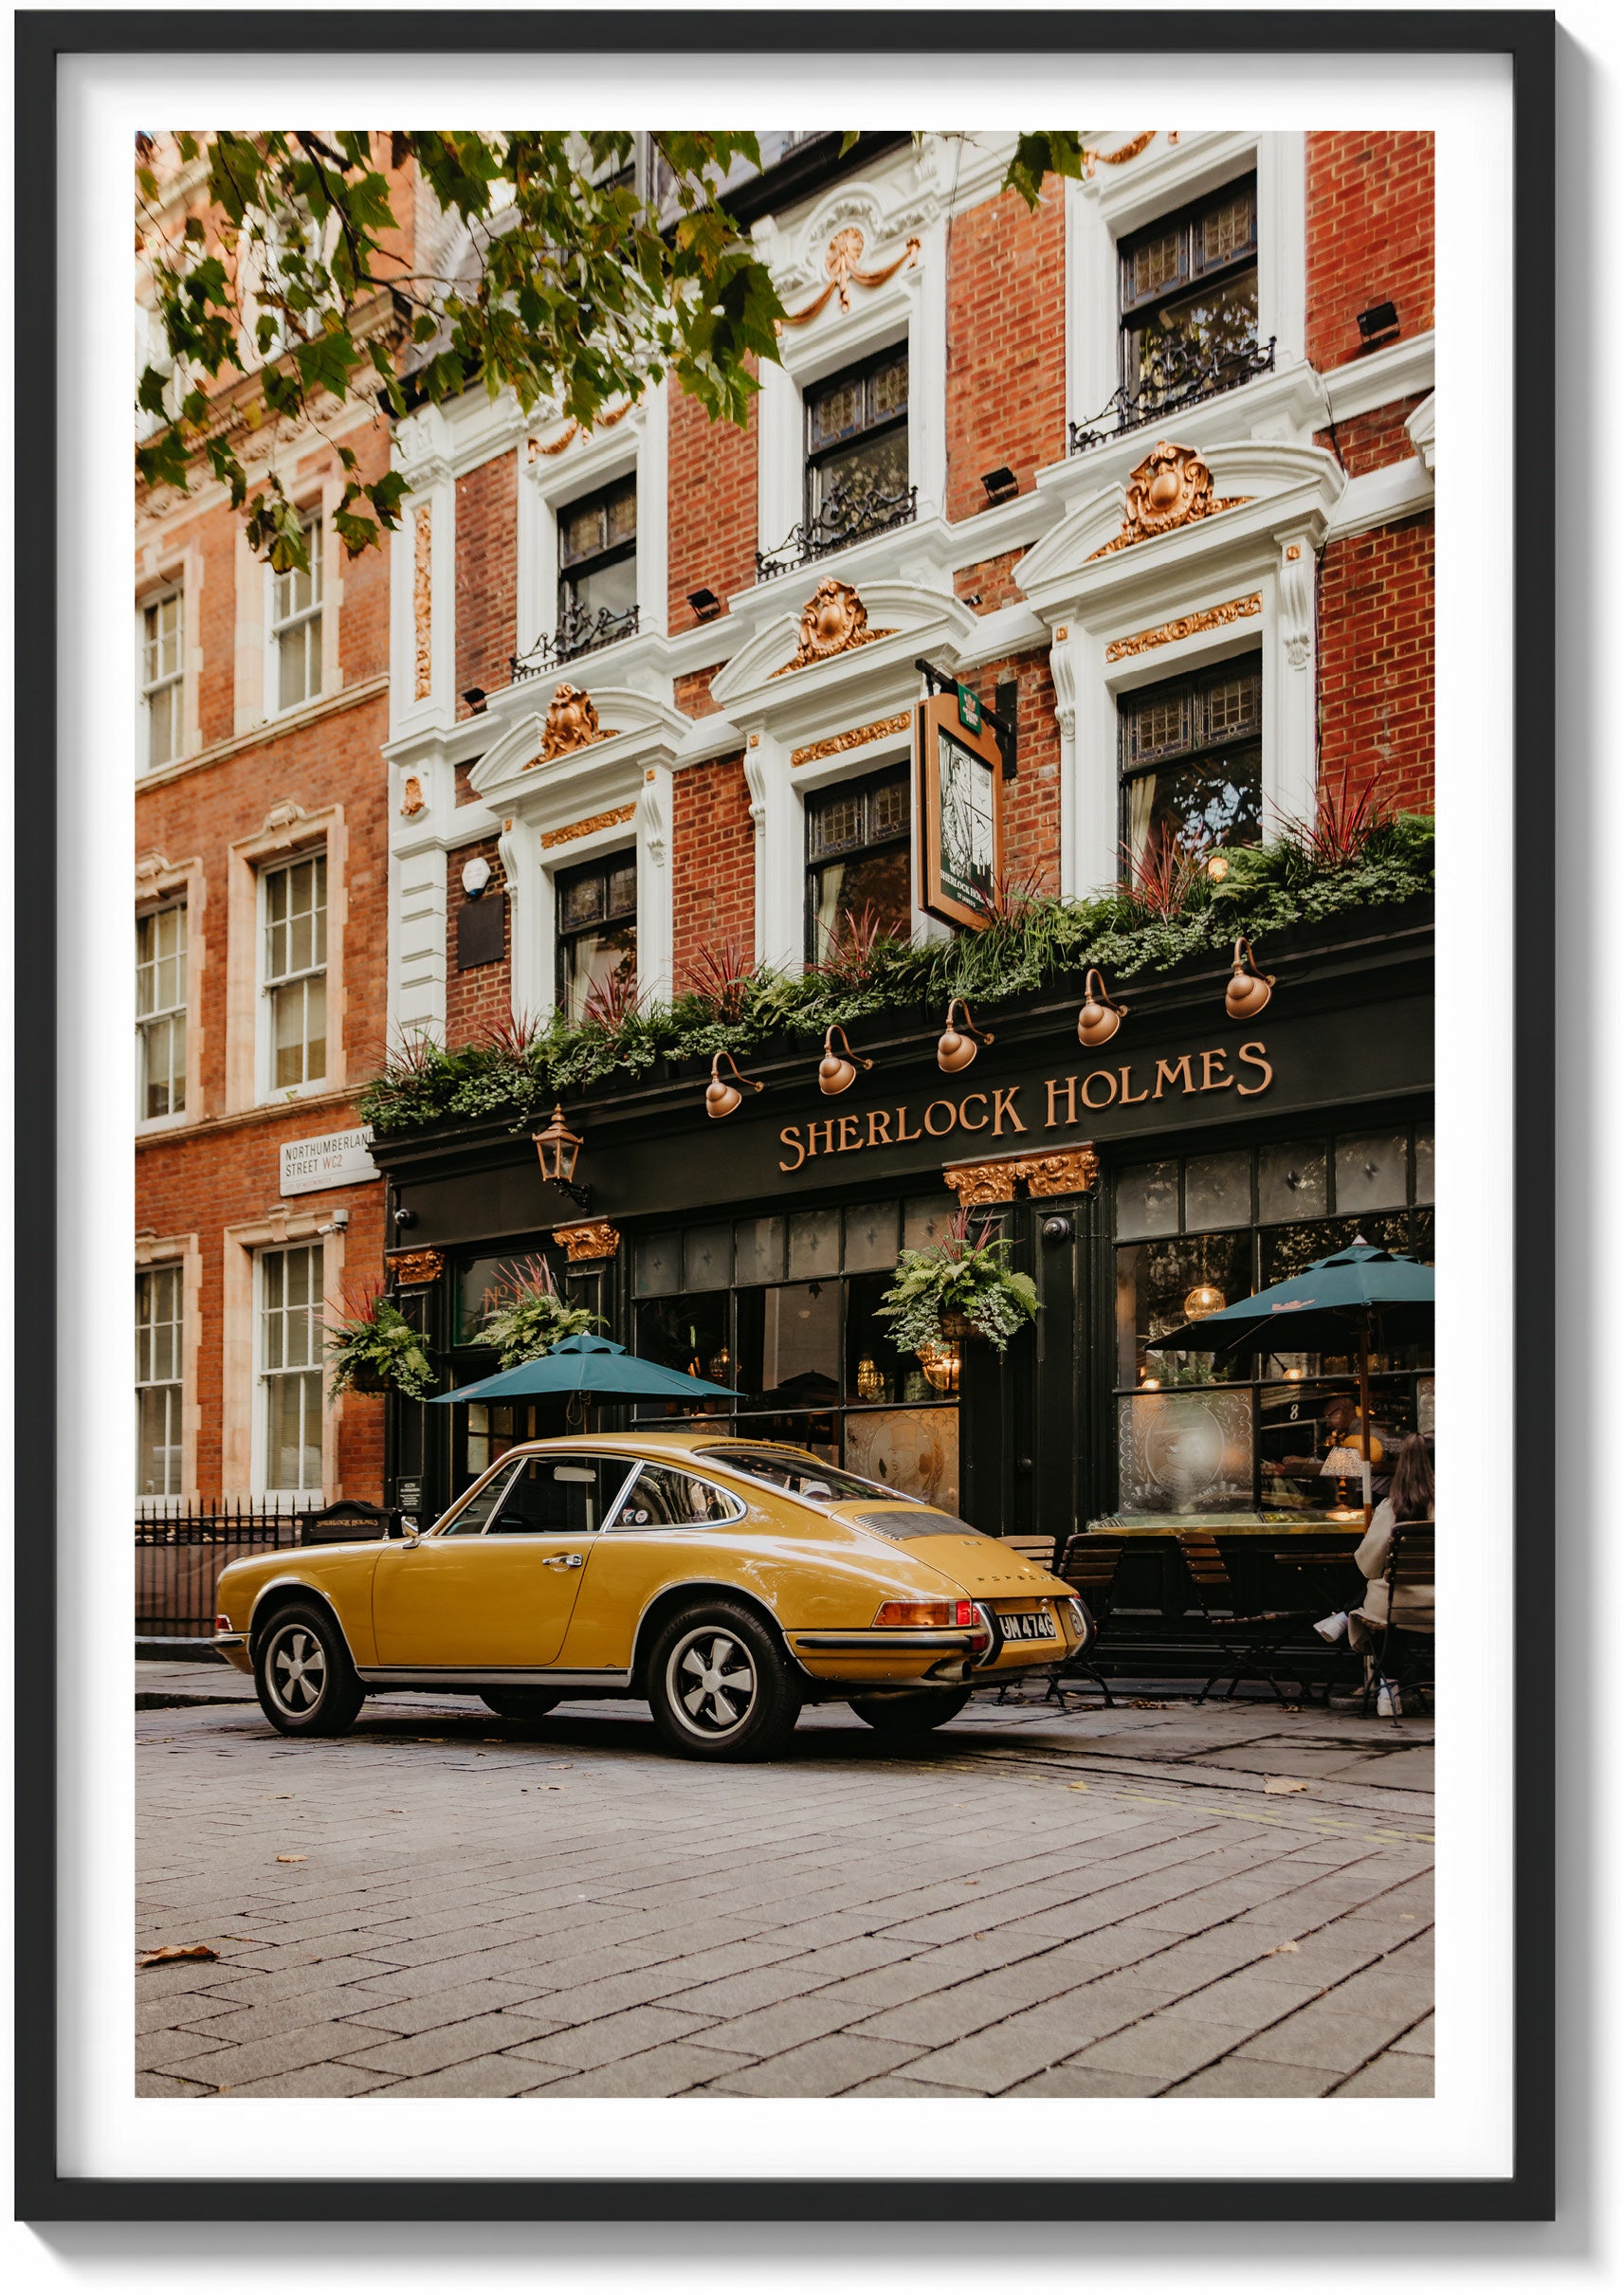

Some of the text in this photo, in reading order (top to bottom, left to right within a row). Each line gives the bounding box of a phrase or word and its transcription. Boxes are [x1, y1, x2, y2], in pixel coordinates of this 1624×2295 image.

[940, 869, 970, 895] SHERLOCK
[778, 1041, 1274, 1172] SHERLOCK HOLMES
[285, 1155, 343, 1177] STREET WC2
[998, 1615, 1022, 1640] UM
[1022, 1614, 1055, 1638] 474G
